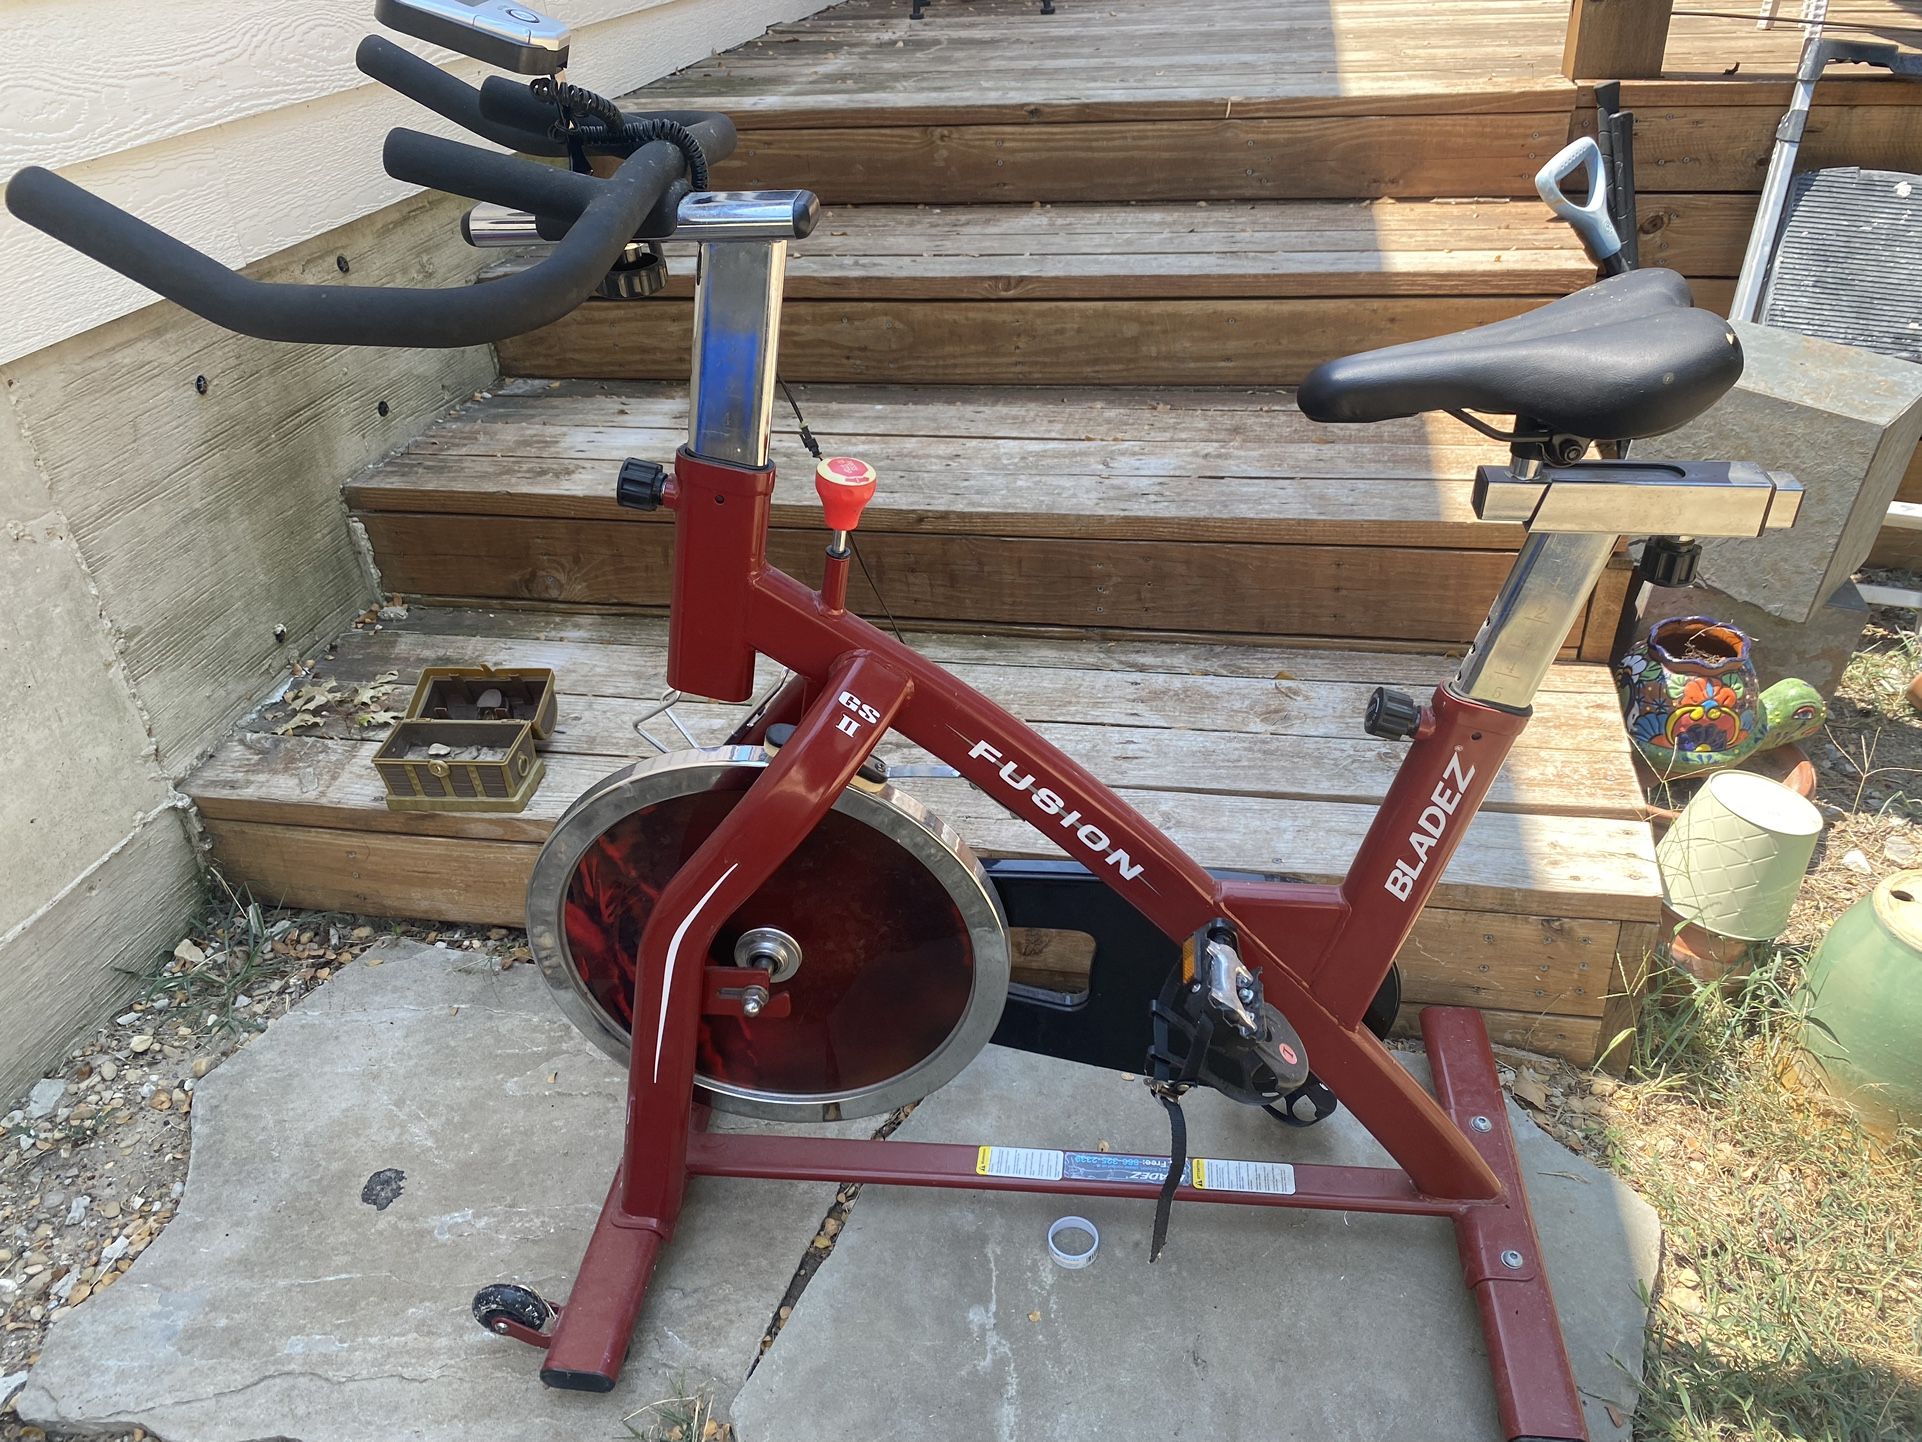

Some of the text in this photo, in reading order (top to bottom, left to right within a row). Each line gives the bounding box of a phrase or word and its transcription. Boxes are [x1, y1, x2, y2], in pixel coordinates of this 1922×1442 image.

[1534, 607, 1548, 620] 2
[838, 691, 881, 724] GS
[835, 713, 862, 738] II
[967, 739, 1145, 881] FUSION
[1384, 752, 1476, 903] BLADEZ
[1142, 1159, 1167, 1168] Free:
